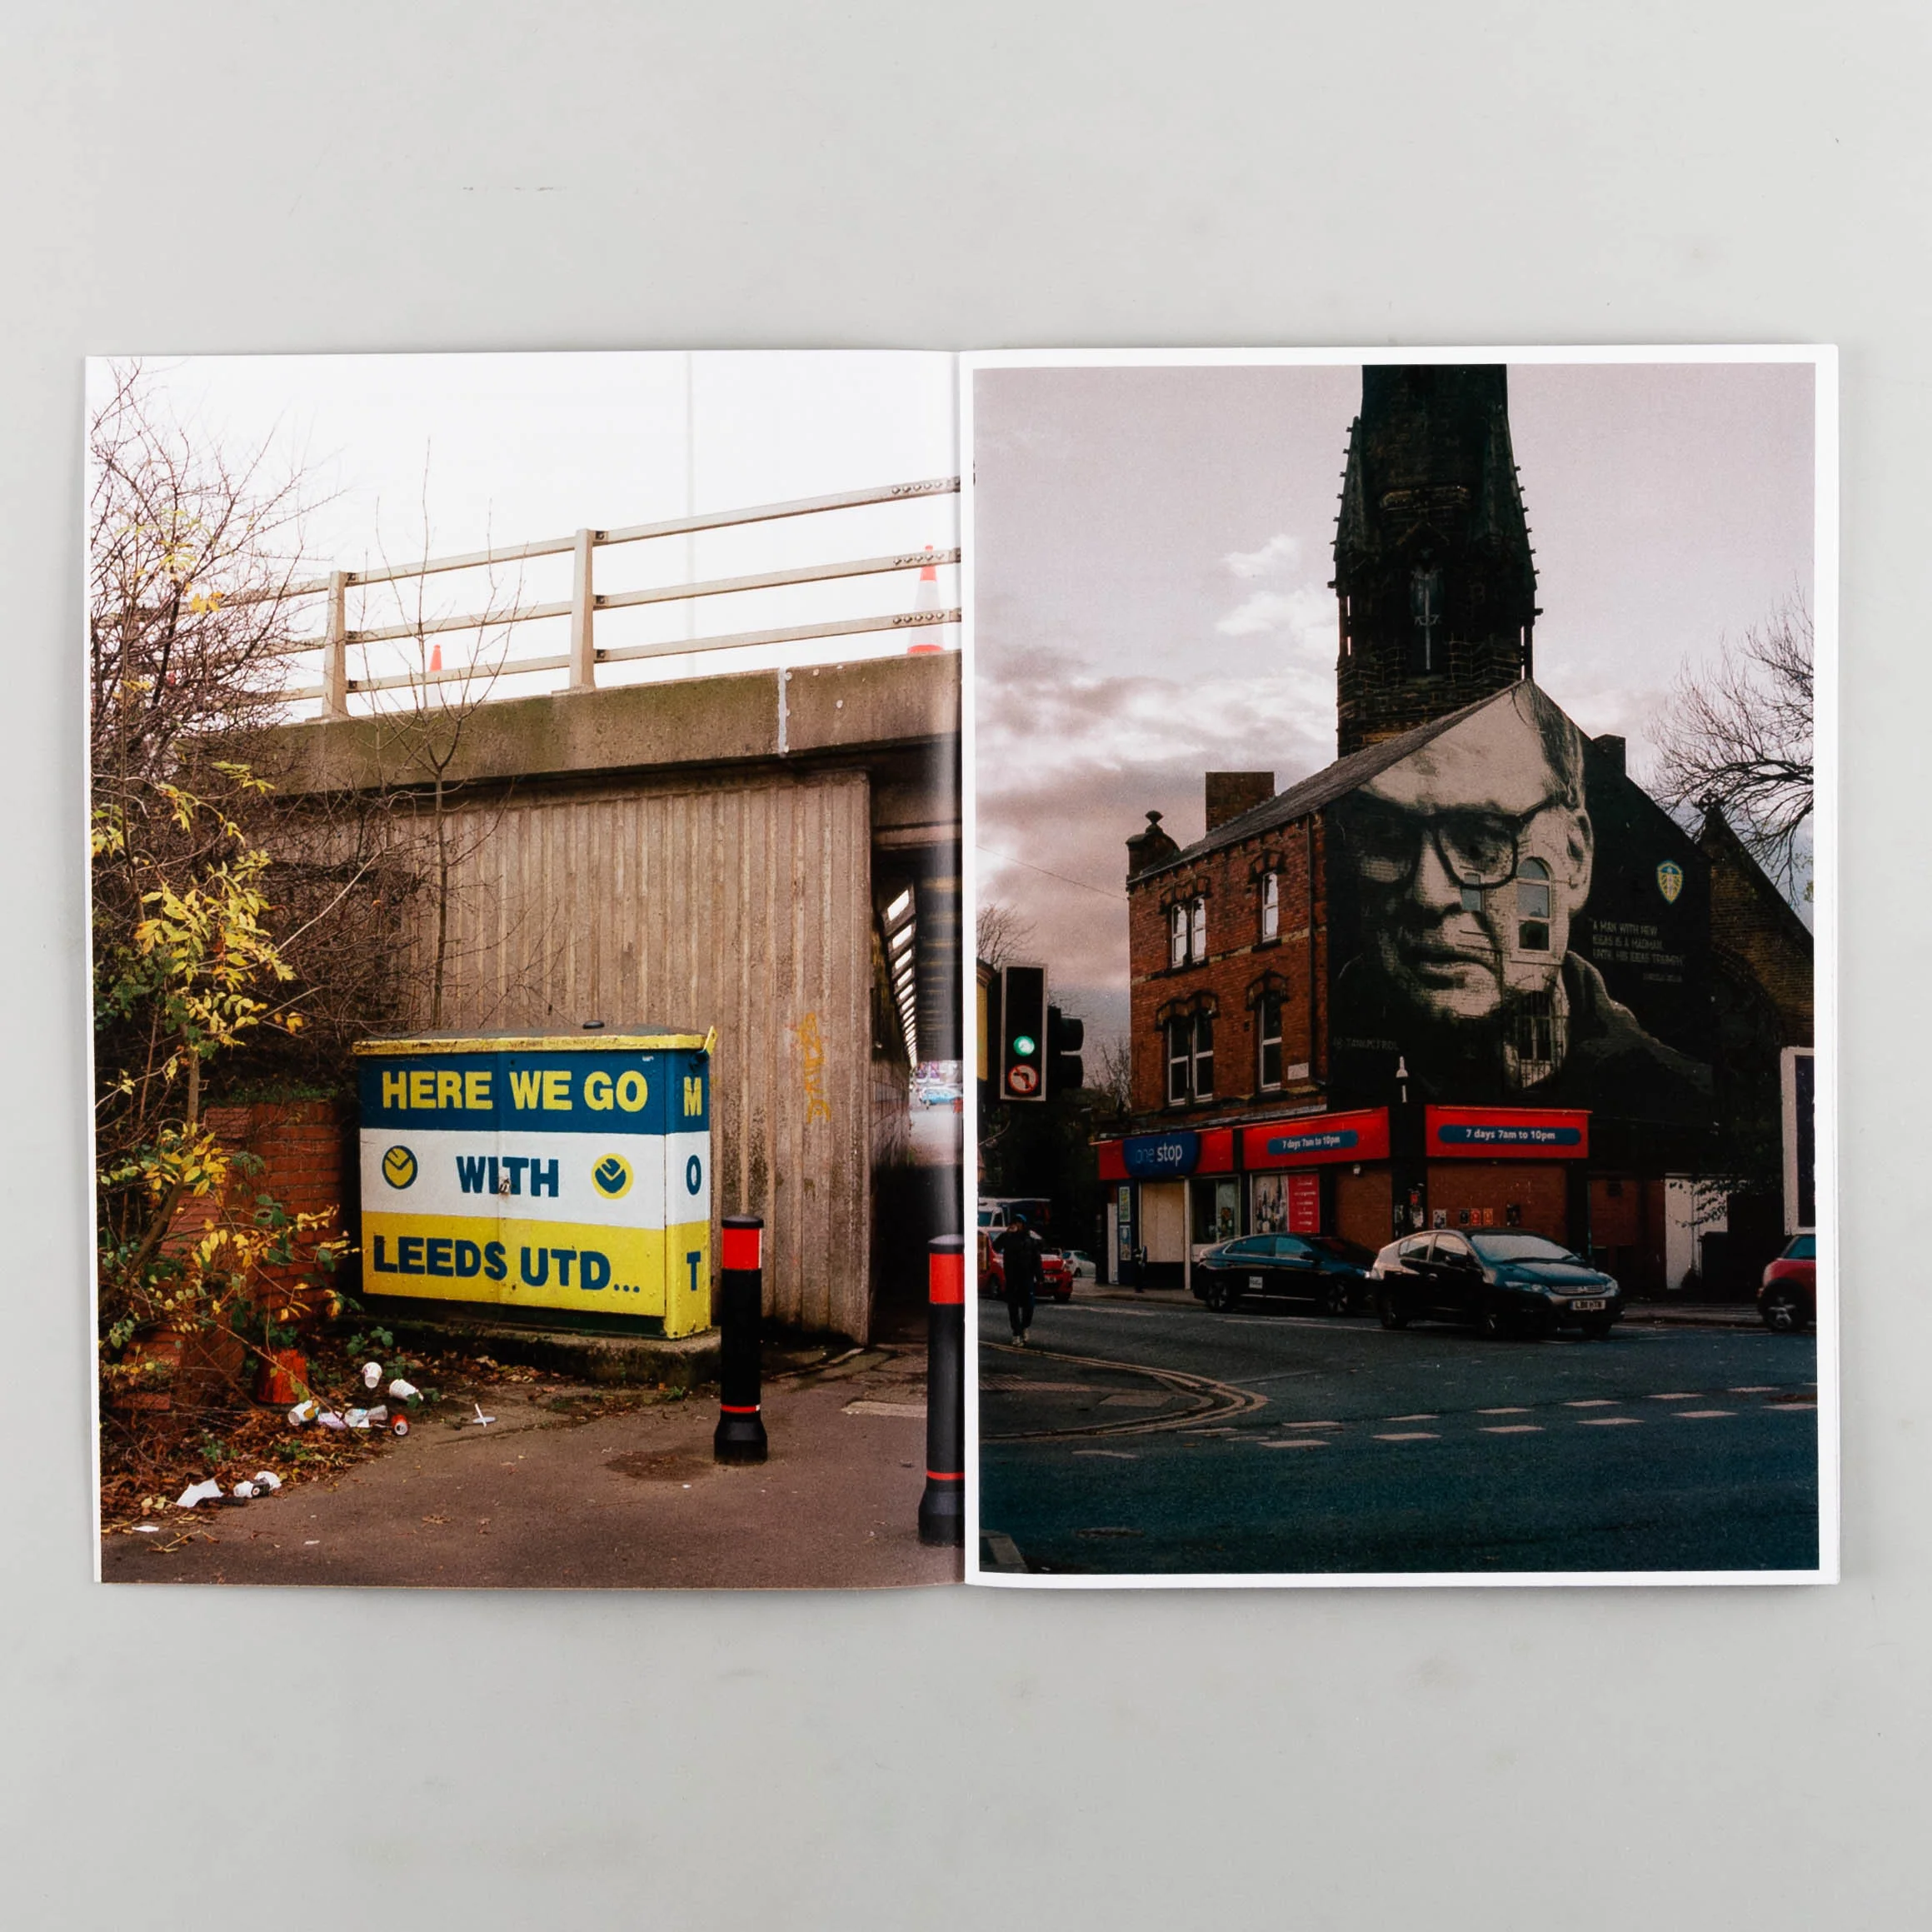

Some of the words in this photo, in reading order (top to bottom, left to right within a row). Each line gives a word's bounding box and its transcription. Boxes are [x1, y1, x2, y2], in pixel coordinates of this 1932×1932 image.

[1619, 922, 1639, 936] WITH
[382, 1071, 493, 1111] HERE
[510, 1070, 573, 1111] WE
[583, 1070, 649, 1112] GO
[1282, 1140, 1286, 1150] 7
[1287, 1139, 1300, 1150] days
[1301, 1138, 1315, 1147] 7am
[1315, 1137, 1321, 1146] to
[1323, 1135, 1340, 1147] 10pm
[1465, 1128, 1472, 1138] 7
[1474, 1128, 1495, 1141] days
[1498, 1130, 1517, 1139] 7am
[1519, 1131, 1528, 1139] to
[1530, 1130, 1555, 1142] 10pm
[1136, 1148, 1155, 1164] one
[1156, 1141, 1183, 1167] stop
[456, 1156, 559, 1197] WITH
[372, 1235, 507, 1281] LEEDS
